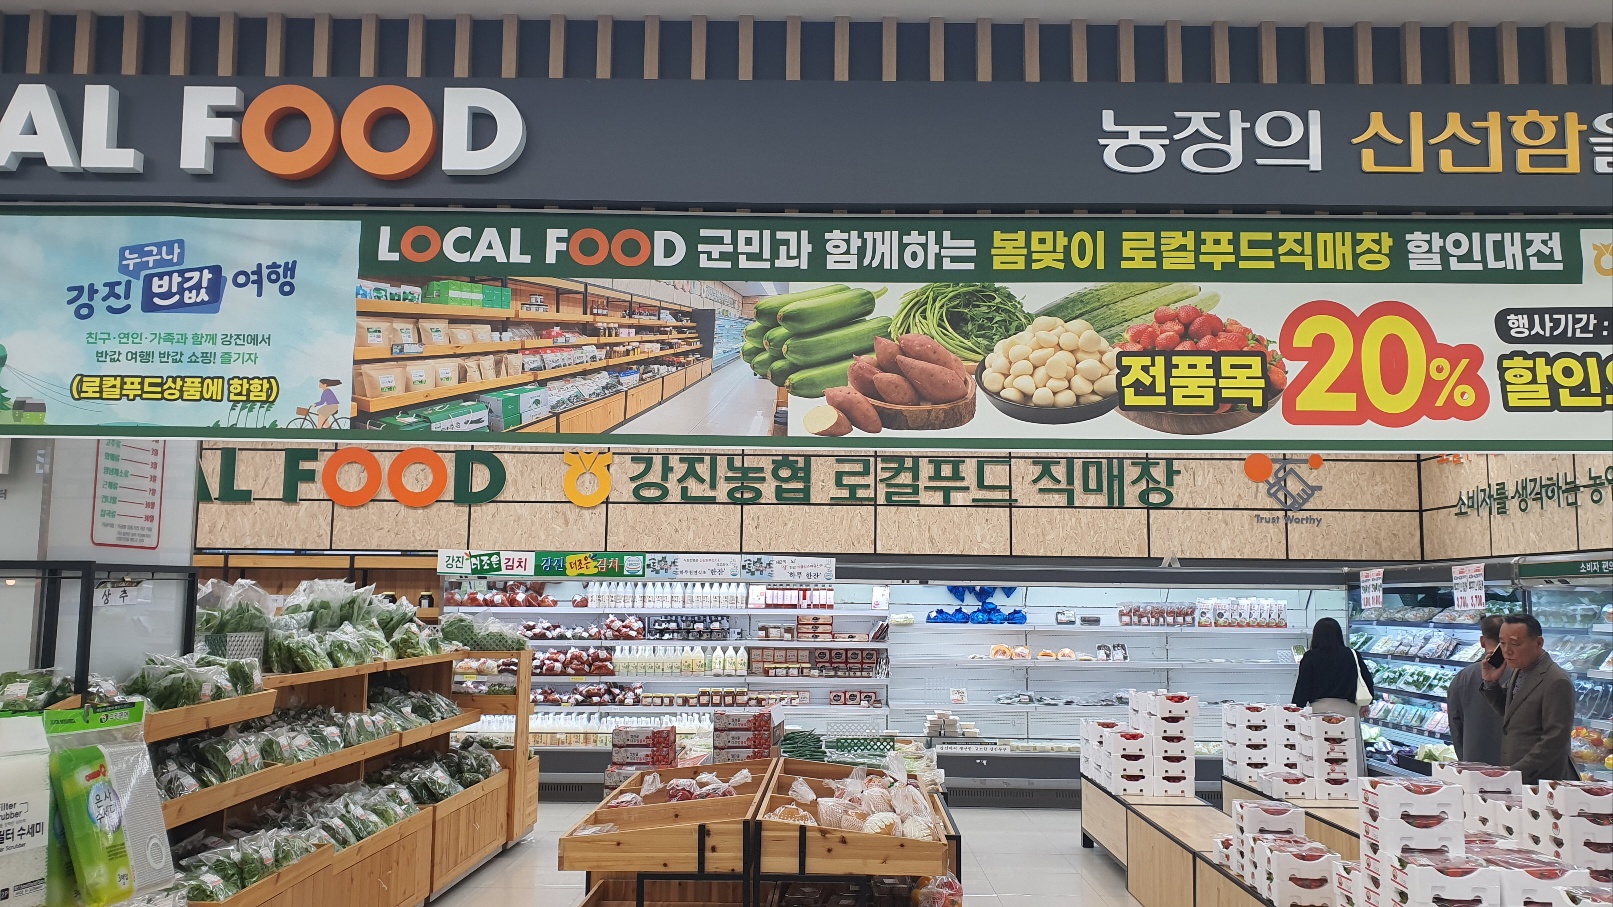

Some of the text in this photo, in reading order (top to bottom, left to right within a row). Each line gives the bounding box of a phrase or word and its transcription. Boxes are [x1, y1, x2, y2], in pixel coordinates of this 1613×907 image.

[180, 84, 526, 180] FOOD
[1097, 109, 1322, 174] 농장의
[121, 243, 181, 271] 누구나
[378, 225, 1564, 272] LOCAL FOOD 군민과 함께하는 봄맞이 로컬푸드직매장 할인대전
[66, 260, 297, 320] 강진 반값 여행
[191, 332, 217, 346] 함께
[220, 332, 271, 347] 강진에서
[1506, 313, 1597, 338] 행사기간
[95, 350, 258, 365] 반값 여행! 반값 쇼핑! 즐기자
[1120, 313, 1476, 415] 전품목 20%
[71, 375, 280, 401] (로컬푸드상품에 한함)
[1502, 356, 1613, 407] 할인
[282, 446, 507, 508] FOOD
[627, 454, 1182, 508] 강진농협 로컬푸드 직매장
[1454, 481, 1509, 518] 소비자를
[1511, 472, 1582, 513] 생각하는
[1254, 514, 1322, 527] Trust Worthy
[445, 555, 465, 569] 강진
[503, 556, 529, 571] 김치
[541, 556, 565, 572] 강진
[596, 557, 620, 573] 김치
[1579, 560, 1600, 573] 소비자
[17, 821, 44, 840] 수세미
